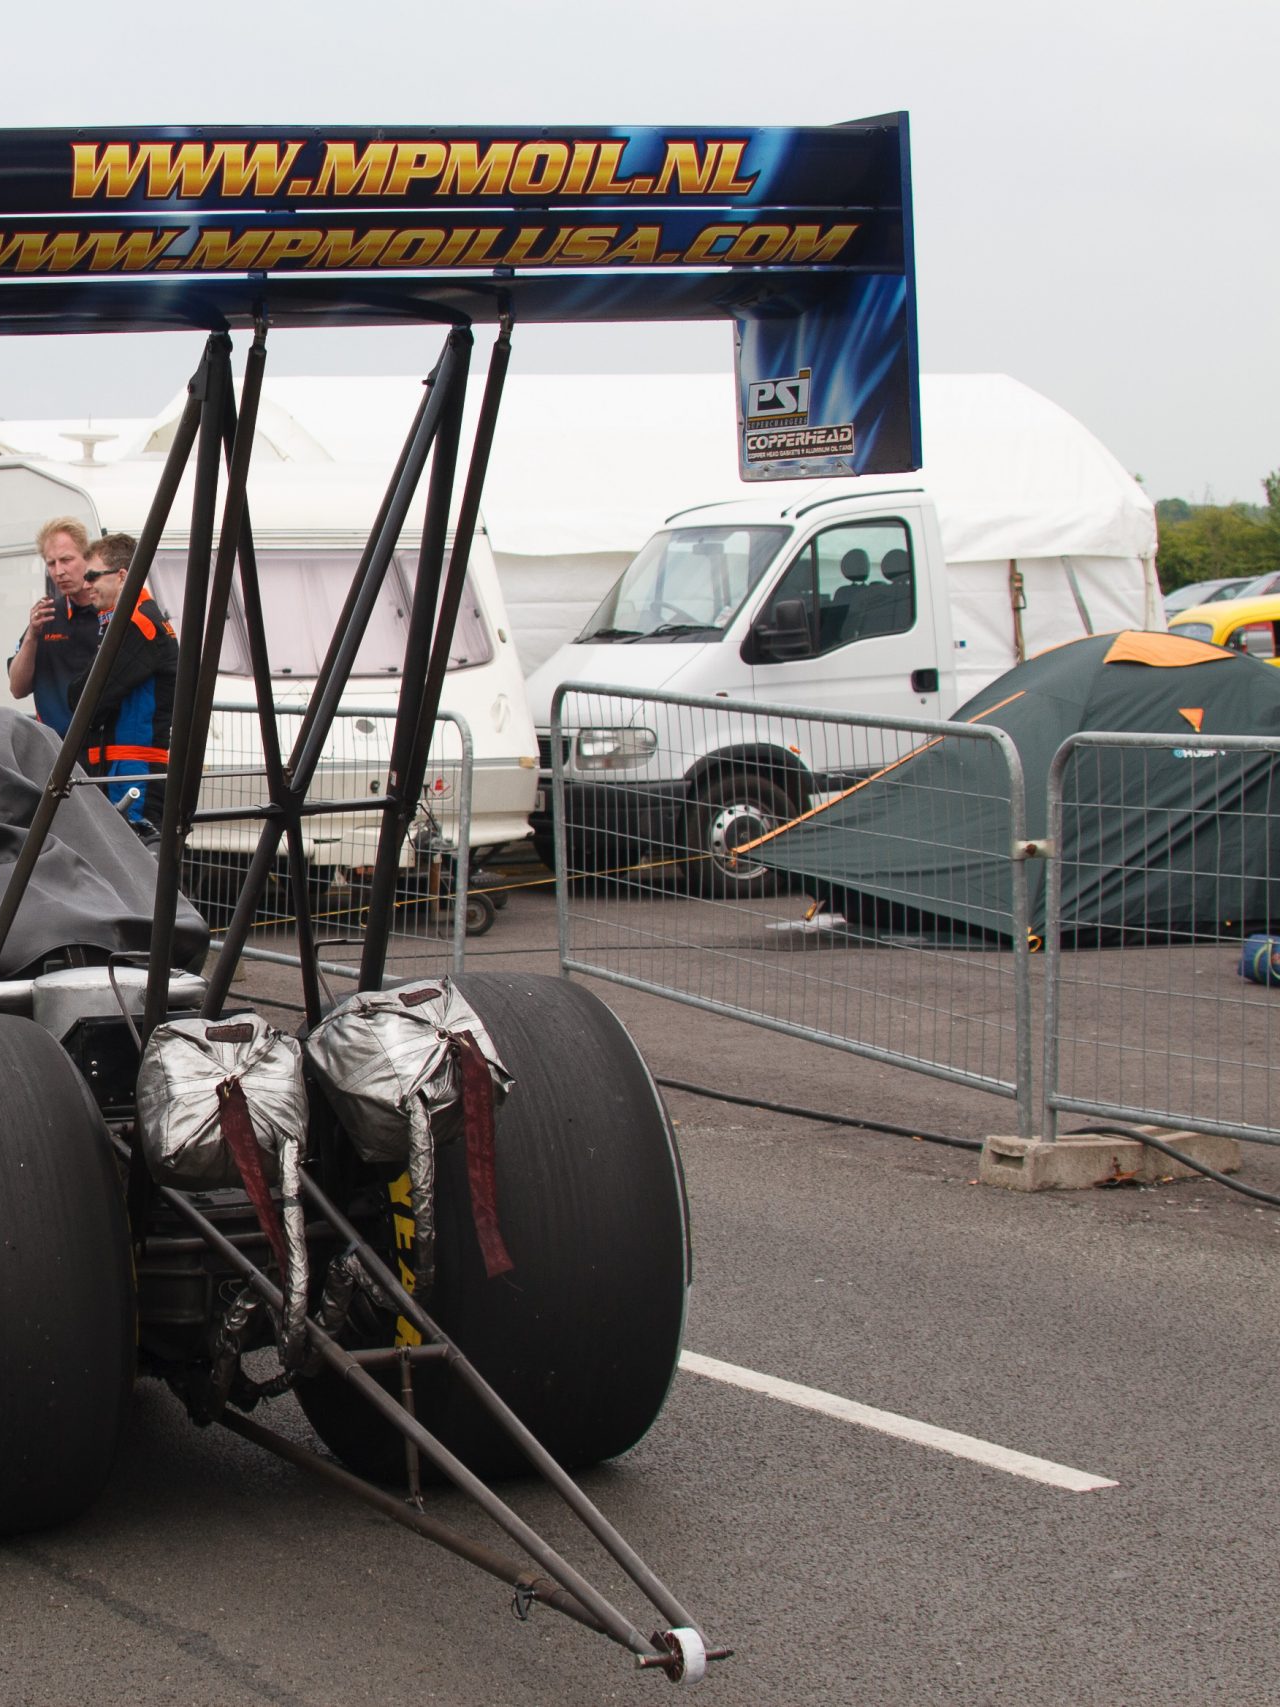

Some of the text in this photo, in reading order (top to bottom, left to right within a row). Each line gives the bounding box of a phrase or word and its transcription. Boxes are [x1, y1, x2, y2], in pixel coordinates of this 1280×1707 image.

[70, 139, 761, 200] WWW.MPMOIL.NL
[748, 370, 809, 418] PSI
[747, 427, 853, 450] COPPERHEAD
